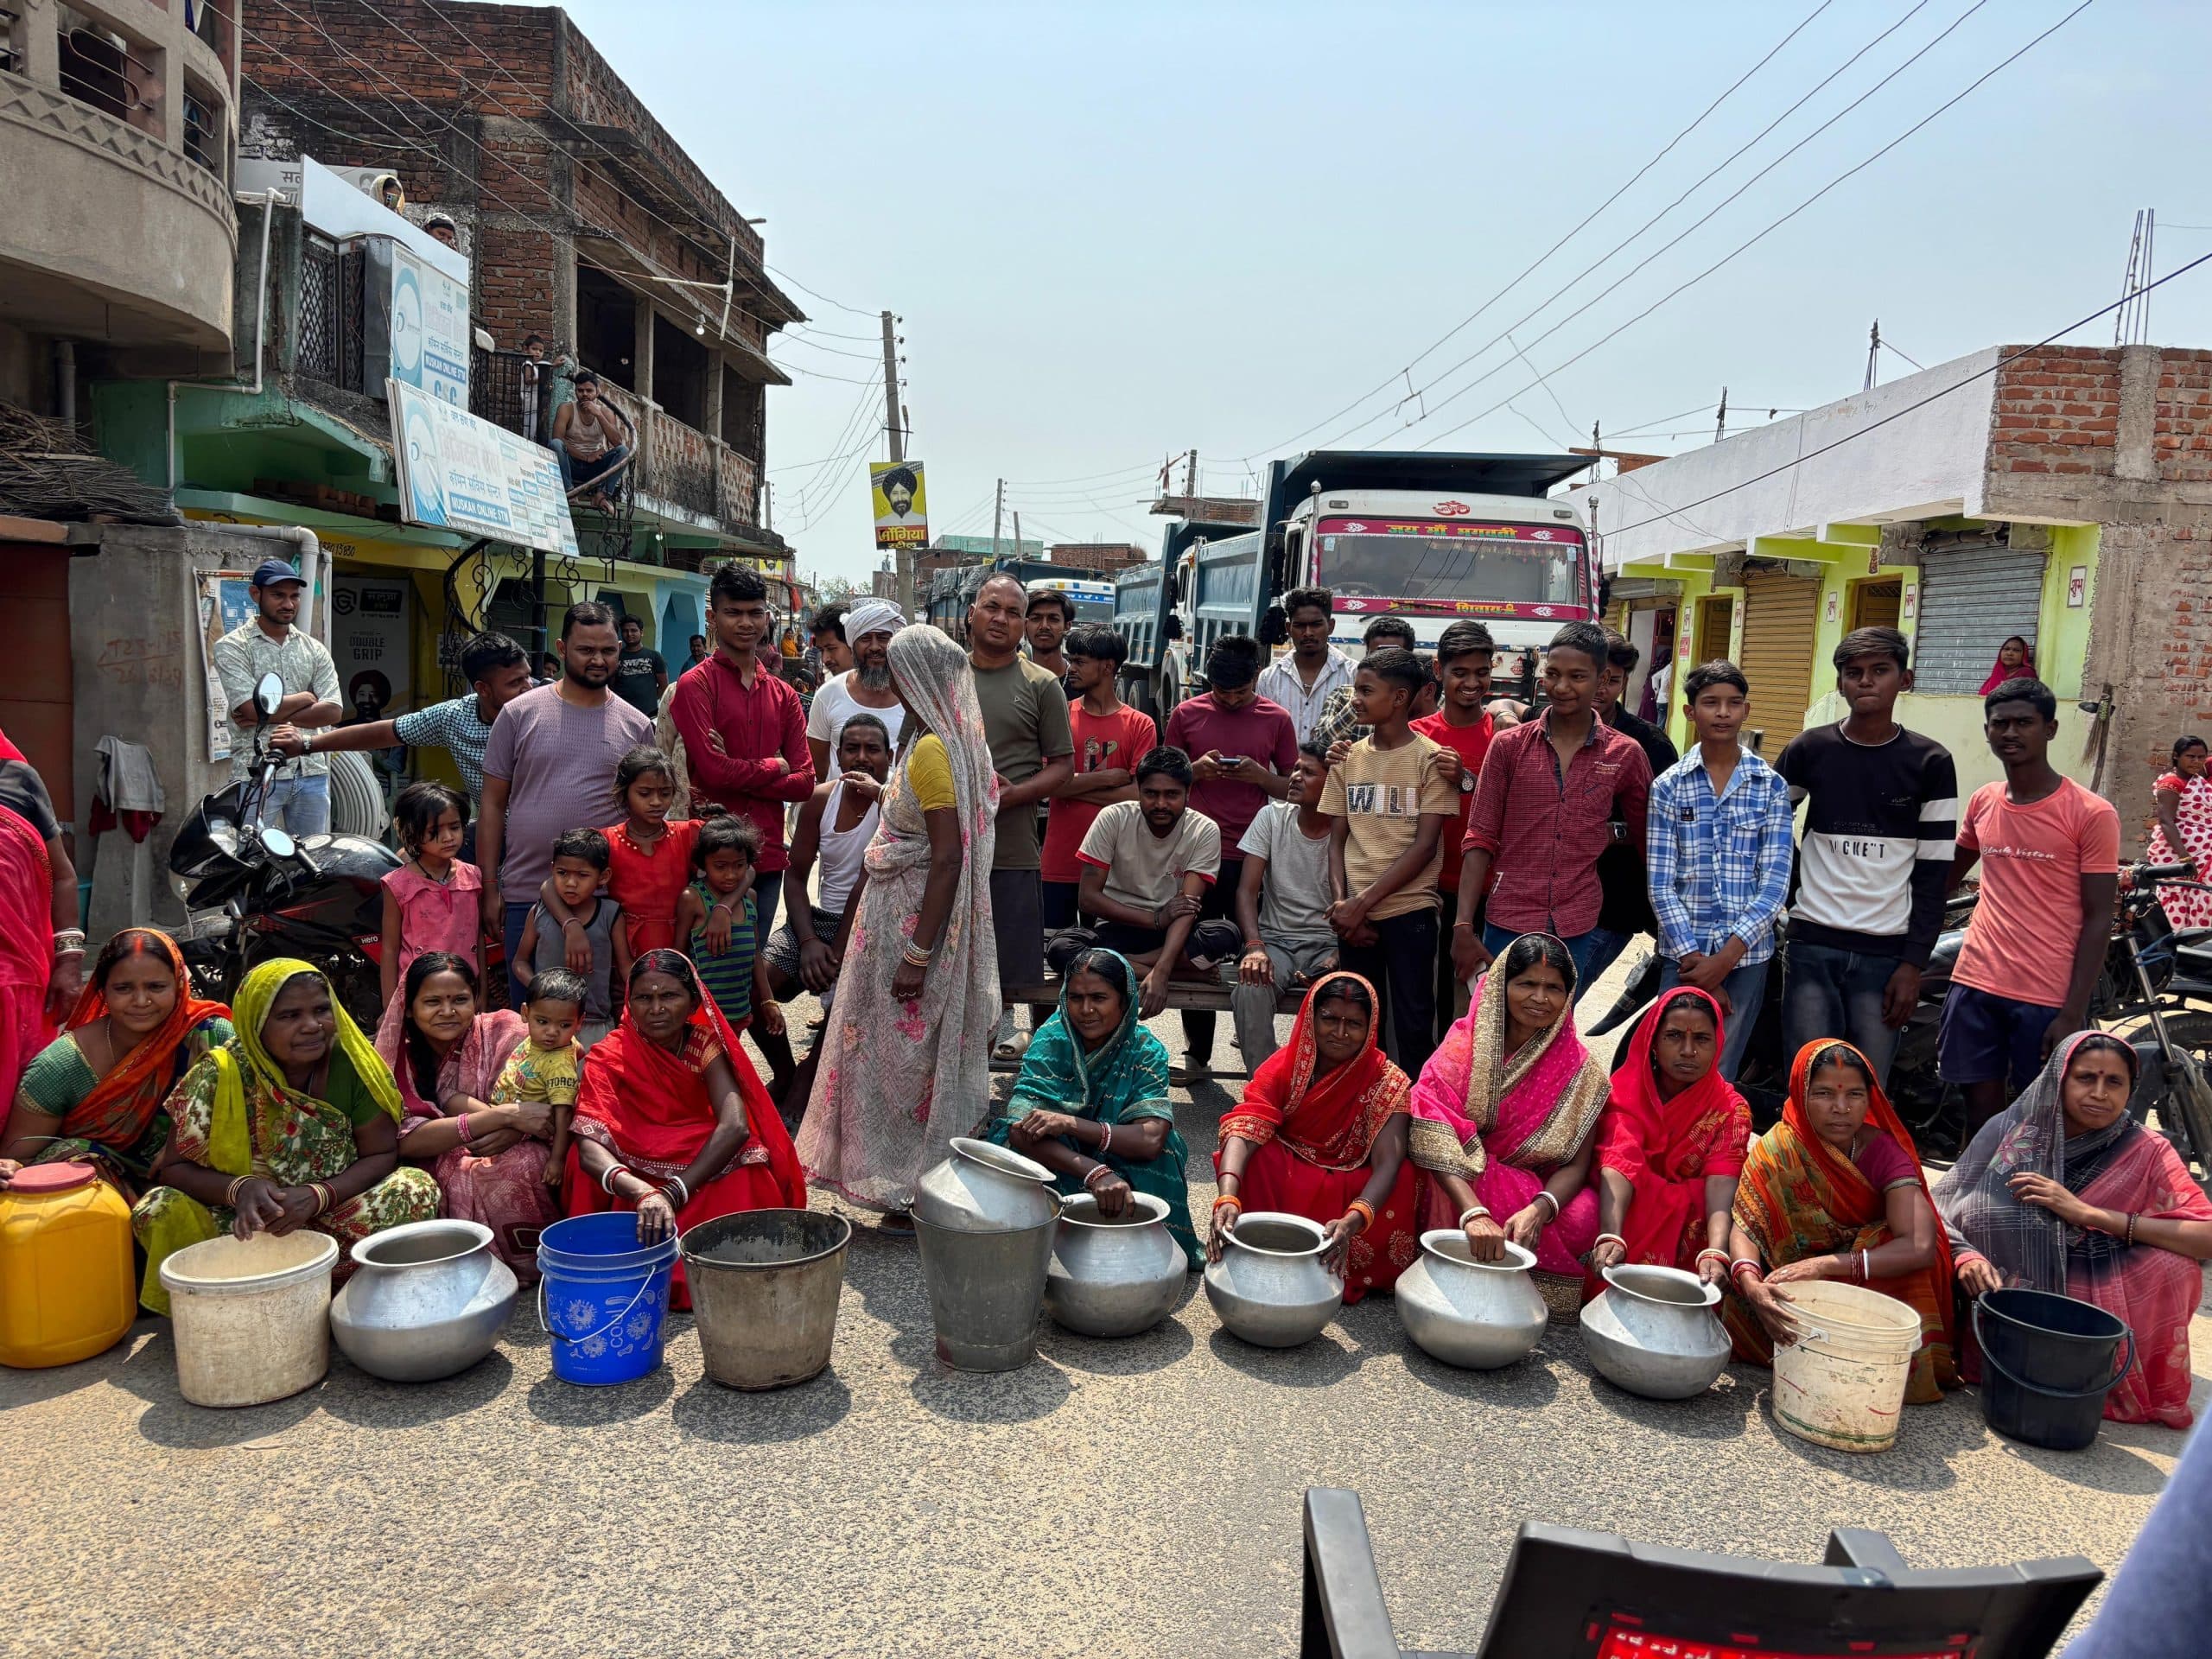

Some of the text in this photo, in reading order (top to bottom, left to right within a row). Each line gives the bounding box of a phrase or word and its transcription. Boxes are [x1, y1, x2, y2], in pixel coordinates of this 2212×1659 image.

[451, 496, 477, 518] MUSKAN
[477, 504, 497, 521] ONLINE
[1385, 524, 1420, 534] जय
[353, 648, 382, 661] GRIP
[1347, 785, 1420, 816] WILL
[361, 936, 378, 944] Hero
